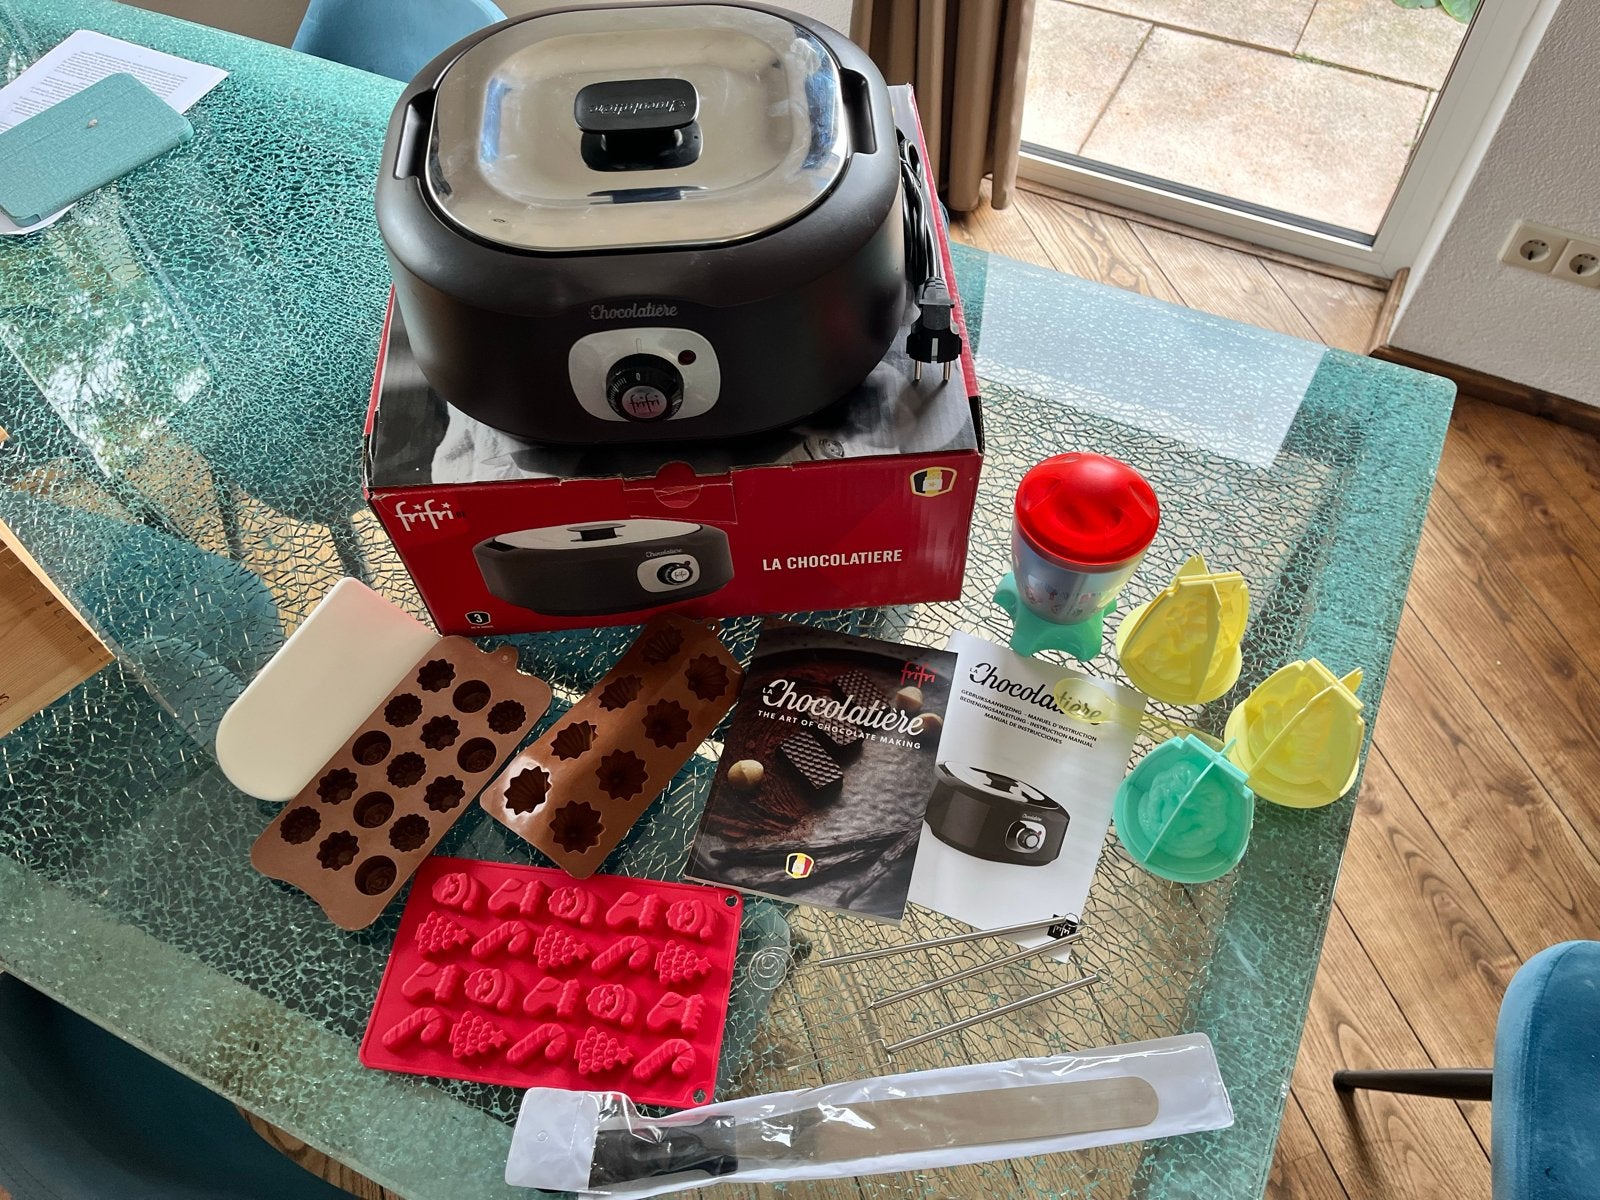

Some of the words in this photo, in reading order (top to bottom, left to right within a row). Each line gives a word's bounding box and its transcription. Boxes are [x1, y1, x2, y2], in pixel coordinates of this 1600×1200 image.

[589, 302, 678, 320] Chocolatière
[629, 394, 660, 414] frifri
[394, 499, 454, 532] frifri
[762, 558, 782, 571] LA
[786, 549, 903, 570] CHOCOLATIERE
[474, 613, 483, 623] 3
[900, 660, 938, 689] frifri
[762, 687, 773, 696] LA
[762, 678, 925, 737] Chocolatière
[959, 696, 1026, 724] BEDIENUNGSANLEITUNG
[1029, 721, 1068, 739] INSTRUCTION
[1068, 736, 1094, 748] MANUAL
[961, 689, 1023, 716] GEBRUIKSAANWIJZING
[1027, 713, 1052, 727] MANUEL
[757, 709, 776, 720] THE
[779, 714, 798, 724] ART
[800, 719, 814, 727] OF
[817, 722, 877, 742] CHOCOLATE
[879, 735, 921, 750] MAKING
[984, 712, 1009, 726] MANUAL
[1017, 724, 1063, 745] INSTRUCCIONES
